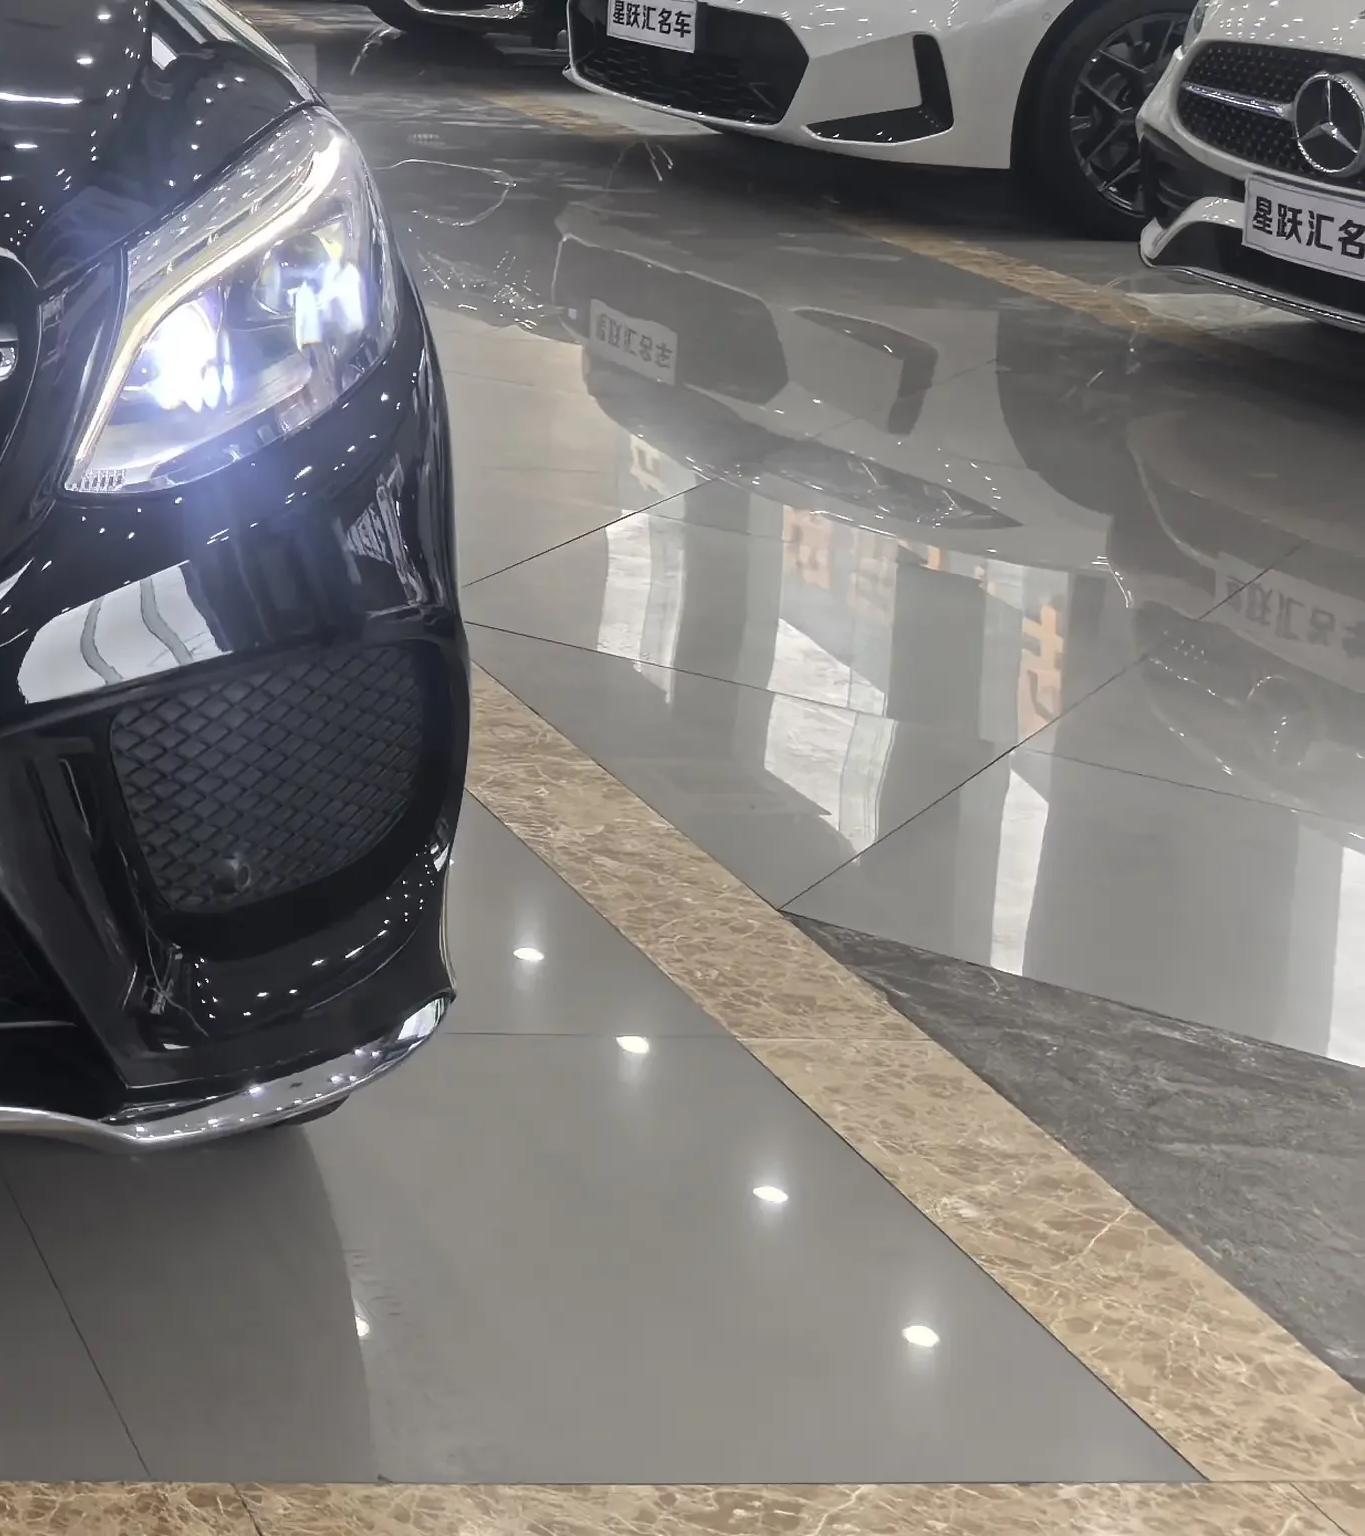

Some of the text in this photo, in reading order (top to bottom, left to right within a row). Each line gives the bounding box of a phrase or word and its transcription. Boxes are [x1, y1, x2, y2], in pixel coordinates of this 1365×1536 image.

[612, 0, 692, 39] 星跃汇名车
[1252, 195, 1365, 260] 星跃汇名
